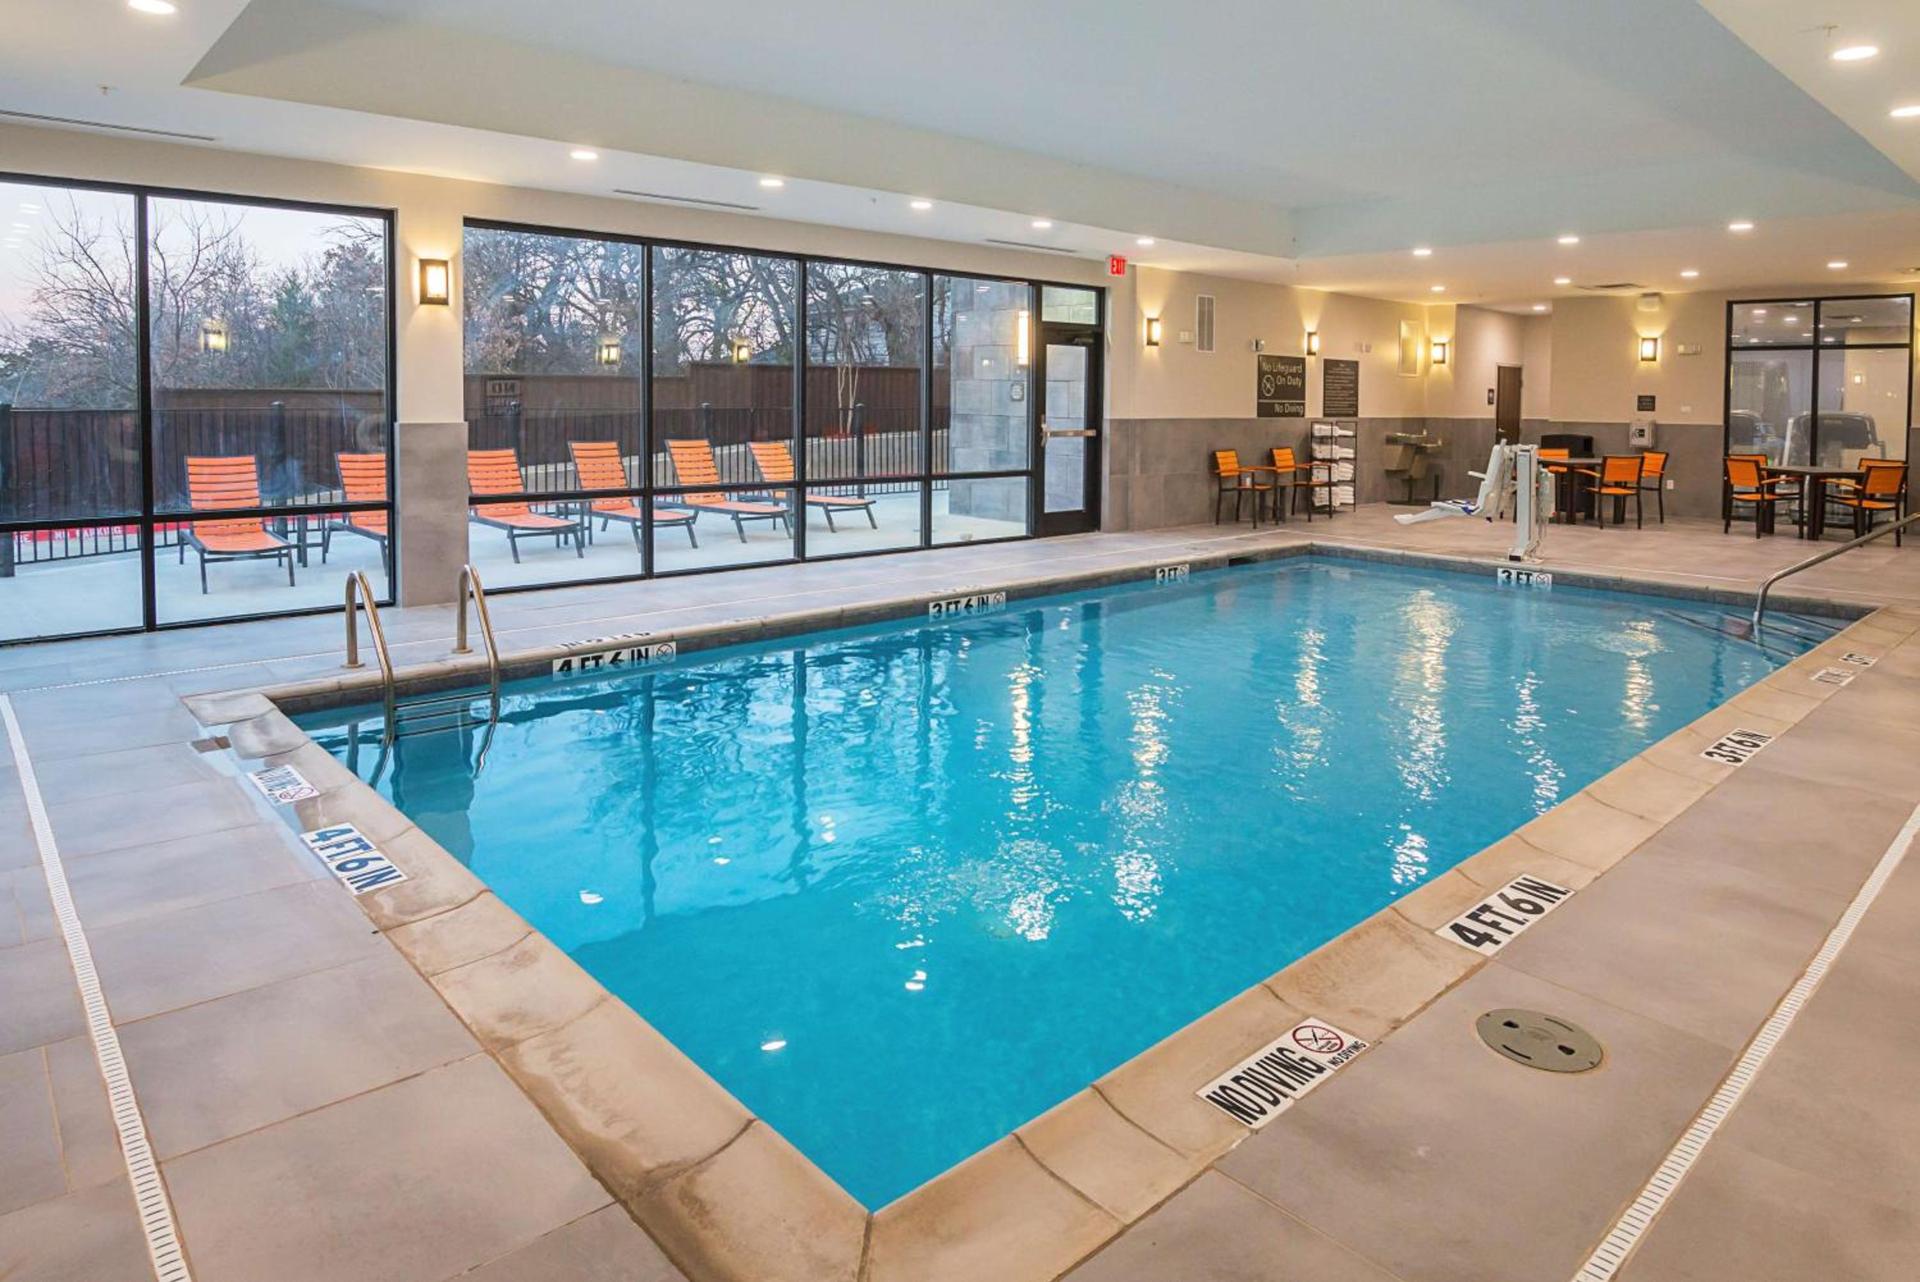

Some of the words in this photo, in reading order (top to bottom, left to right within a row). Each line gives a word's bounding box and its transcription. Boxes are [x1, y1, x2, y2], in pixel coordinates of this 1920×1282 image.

[1110, 256, 1126, 275] EXIT
[1262, 362, 1271, 372] No
[1273, 363, 1303, 375] Lifeguard
[1276, 375, 1286, 385] On
[1287, 376, 1303, 388] Duty
[1274, 404, 1283, 414] No
[1284, 404, 1304, 416] Diving
[630, 647, 649, 665] IN
[1704, 751, 1743, 763] 3
[1726, 737, 1762, 748] 6
[310, 828, 354, 843] 4
[335, 856, 385, 873] 6
[1449, 922, 1502, 948] 4
[1497, 892, 1546, 915] 6
[1327, 1056, 1345, 1068] NO
[1337, 1041, 1367, 1060] DIVING
[1230, 1046, 1327, 1107] DIVING
[1205, 1084, 1268, 1125] NO
